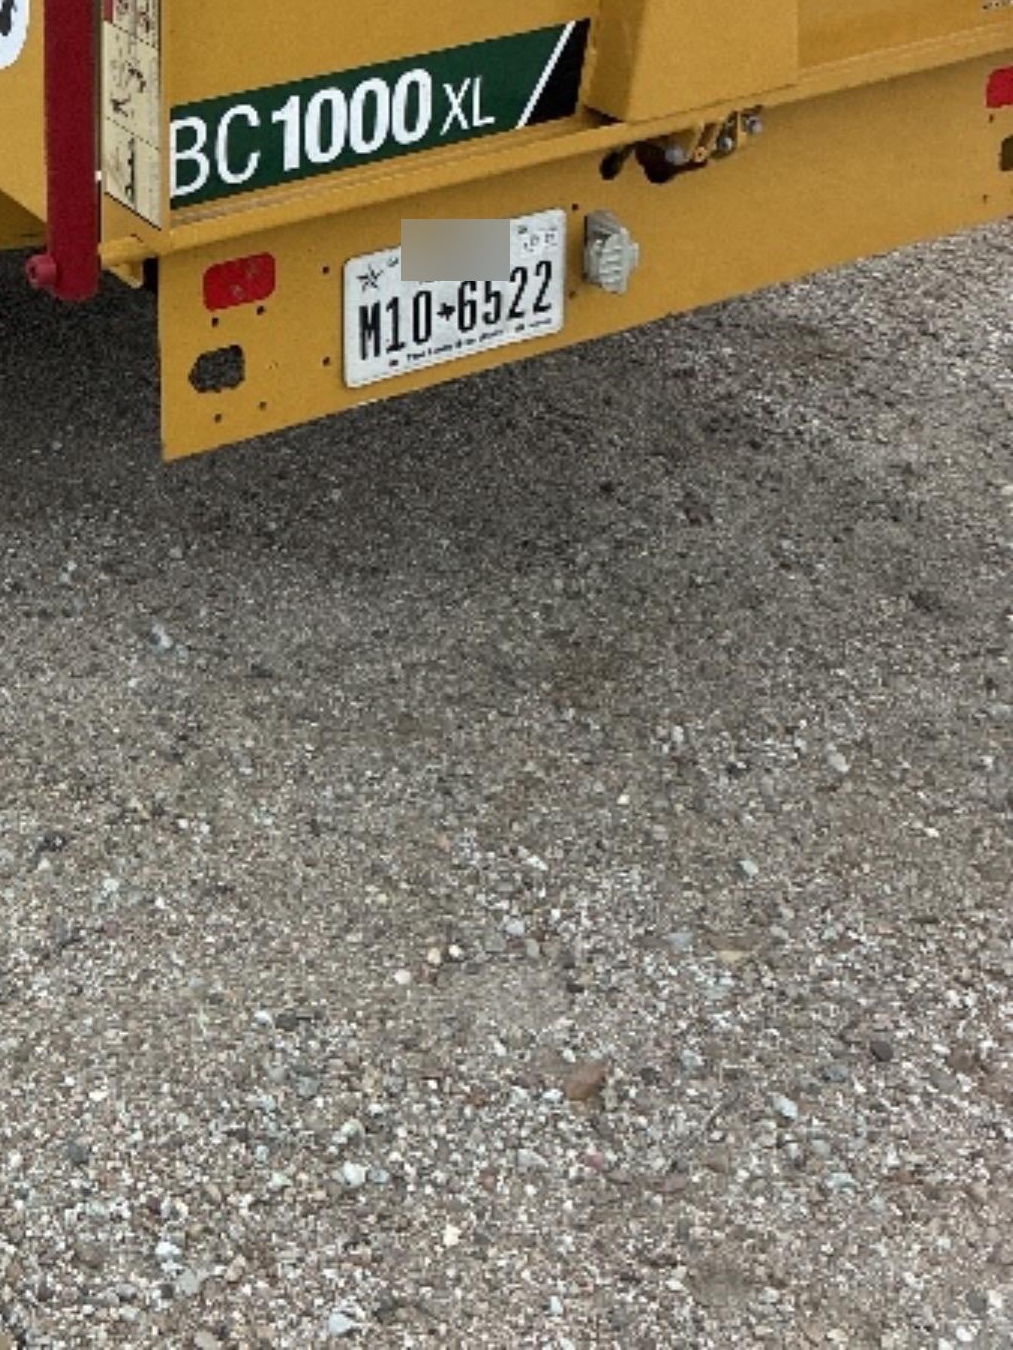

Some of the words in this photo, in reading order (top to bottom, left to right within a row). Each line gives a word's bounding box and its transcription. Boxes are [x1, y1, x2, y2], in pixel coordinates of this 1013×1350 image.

[170, 104, 260, 197] BC
[271, 67, 433, 171] 1000
[440, 75, 496, 136] XL
